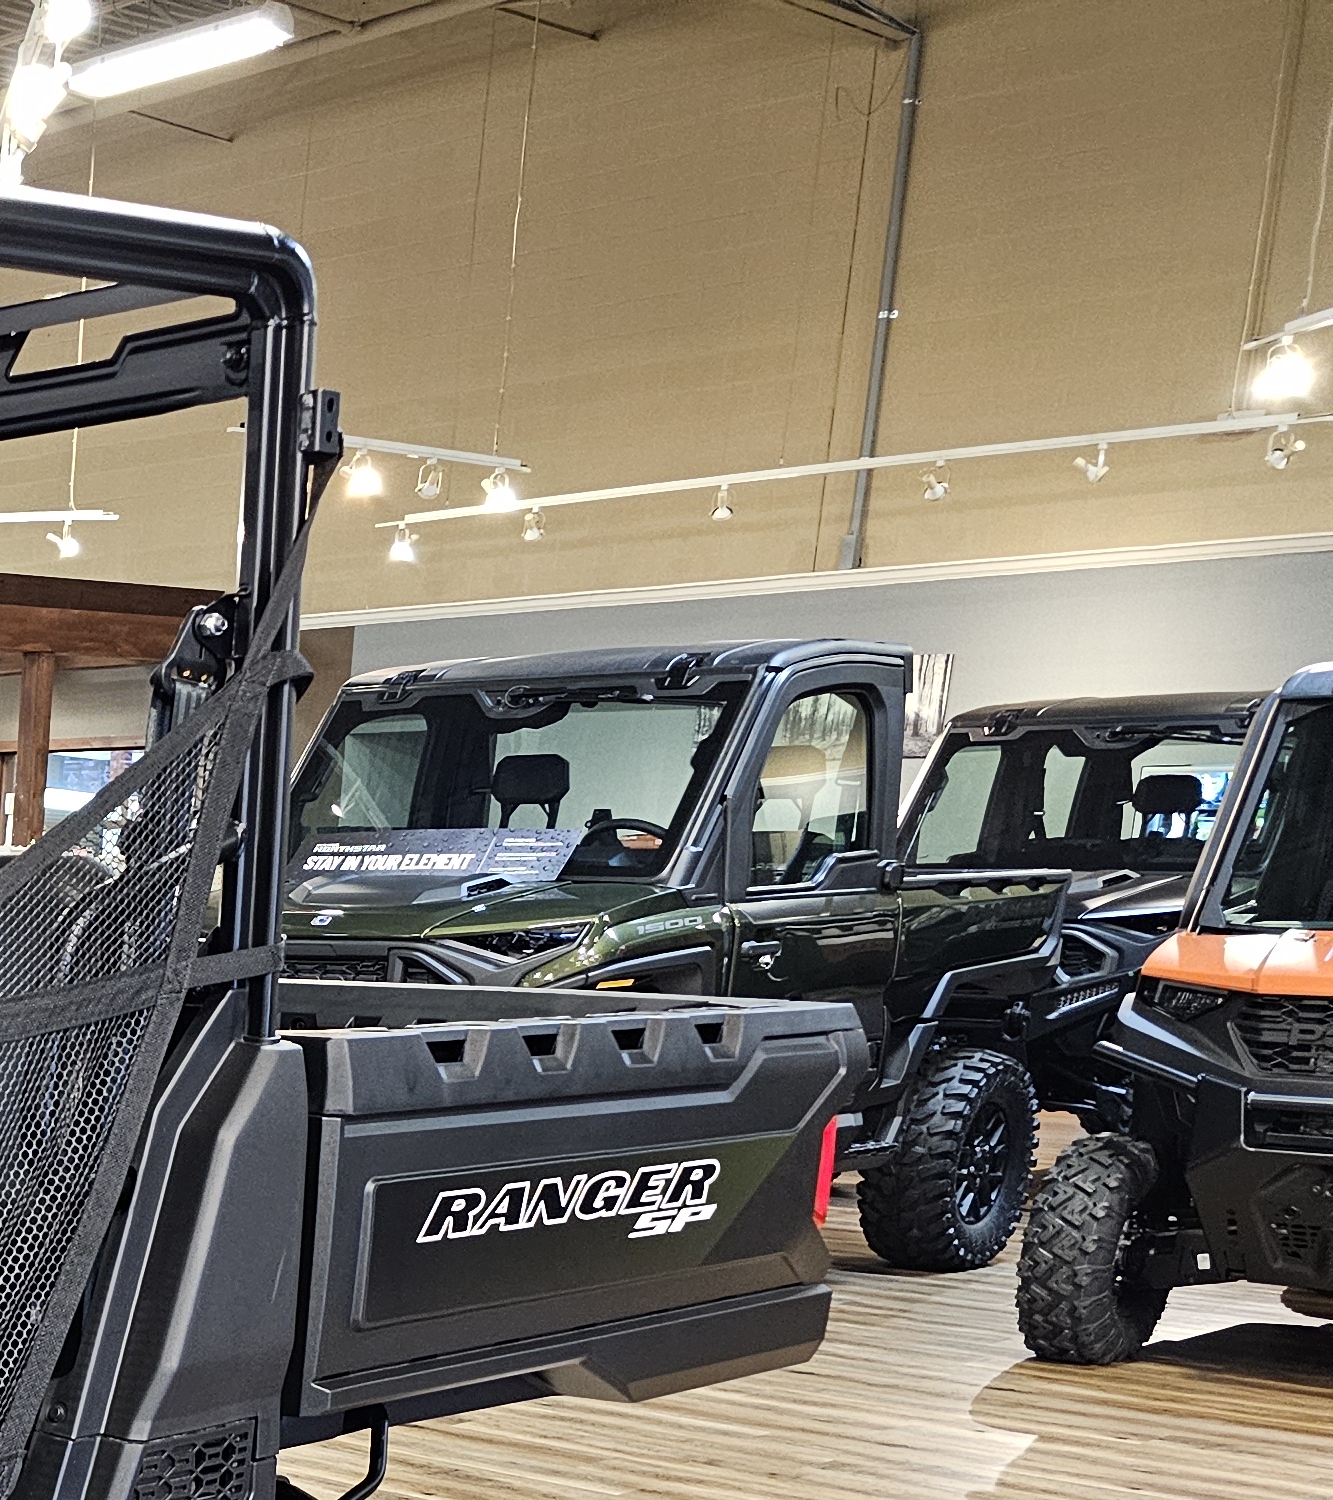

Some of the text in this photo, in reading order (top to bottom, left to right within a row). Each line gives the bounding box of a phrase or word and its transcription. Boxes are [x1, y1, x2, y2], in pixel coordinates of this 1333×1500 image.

[302, 855, 342, 871] STAY
[340, 855, 363, 871] IN
[360, 854, 403, 871] YOUR
[399, 853, 477, 871] ELEMENT
[636, 915, 703, 935] 1500
[416, 1158, 721, 1243] RANGER
[627, 1203, 718, 1239] SP
